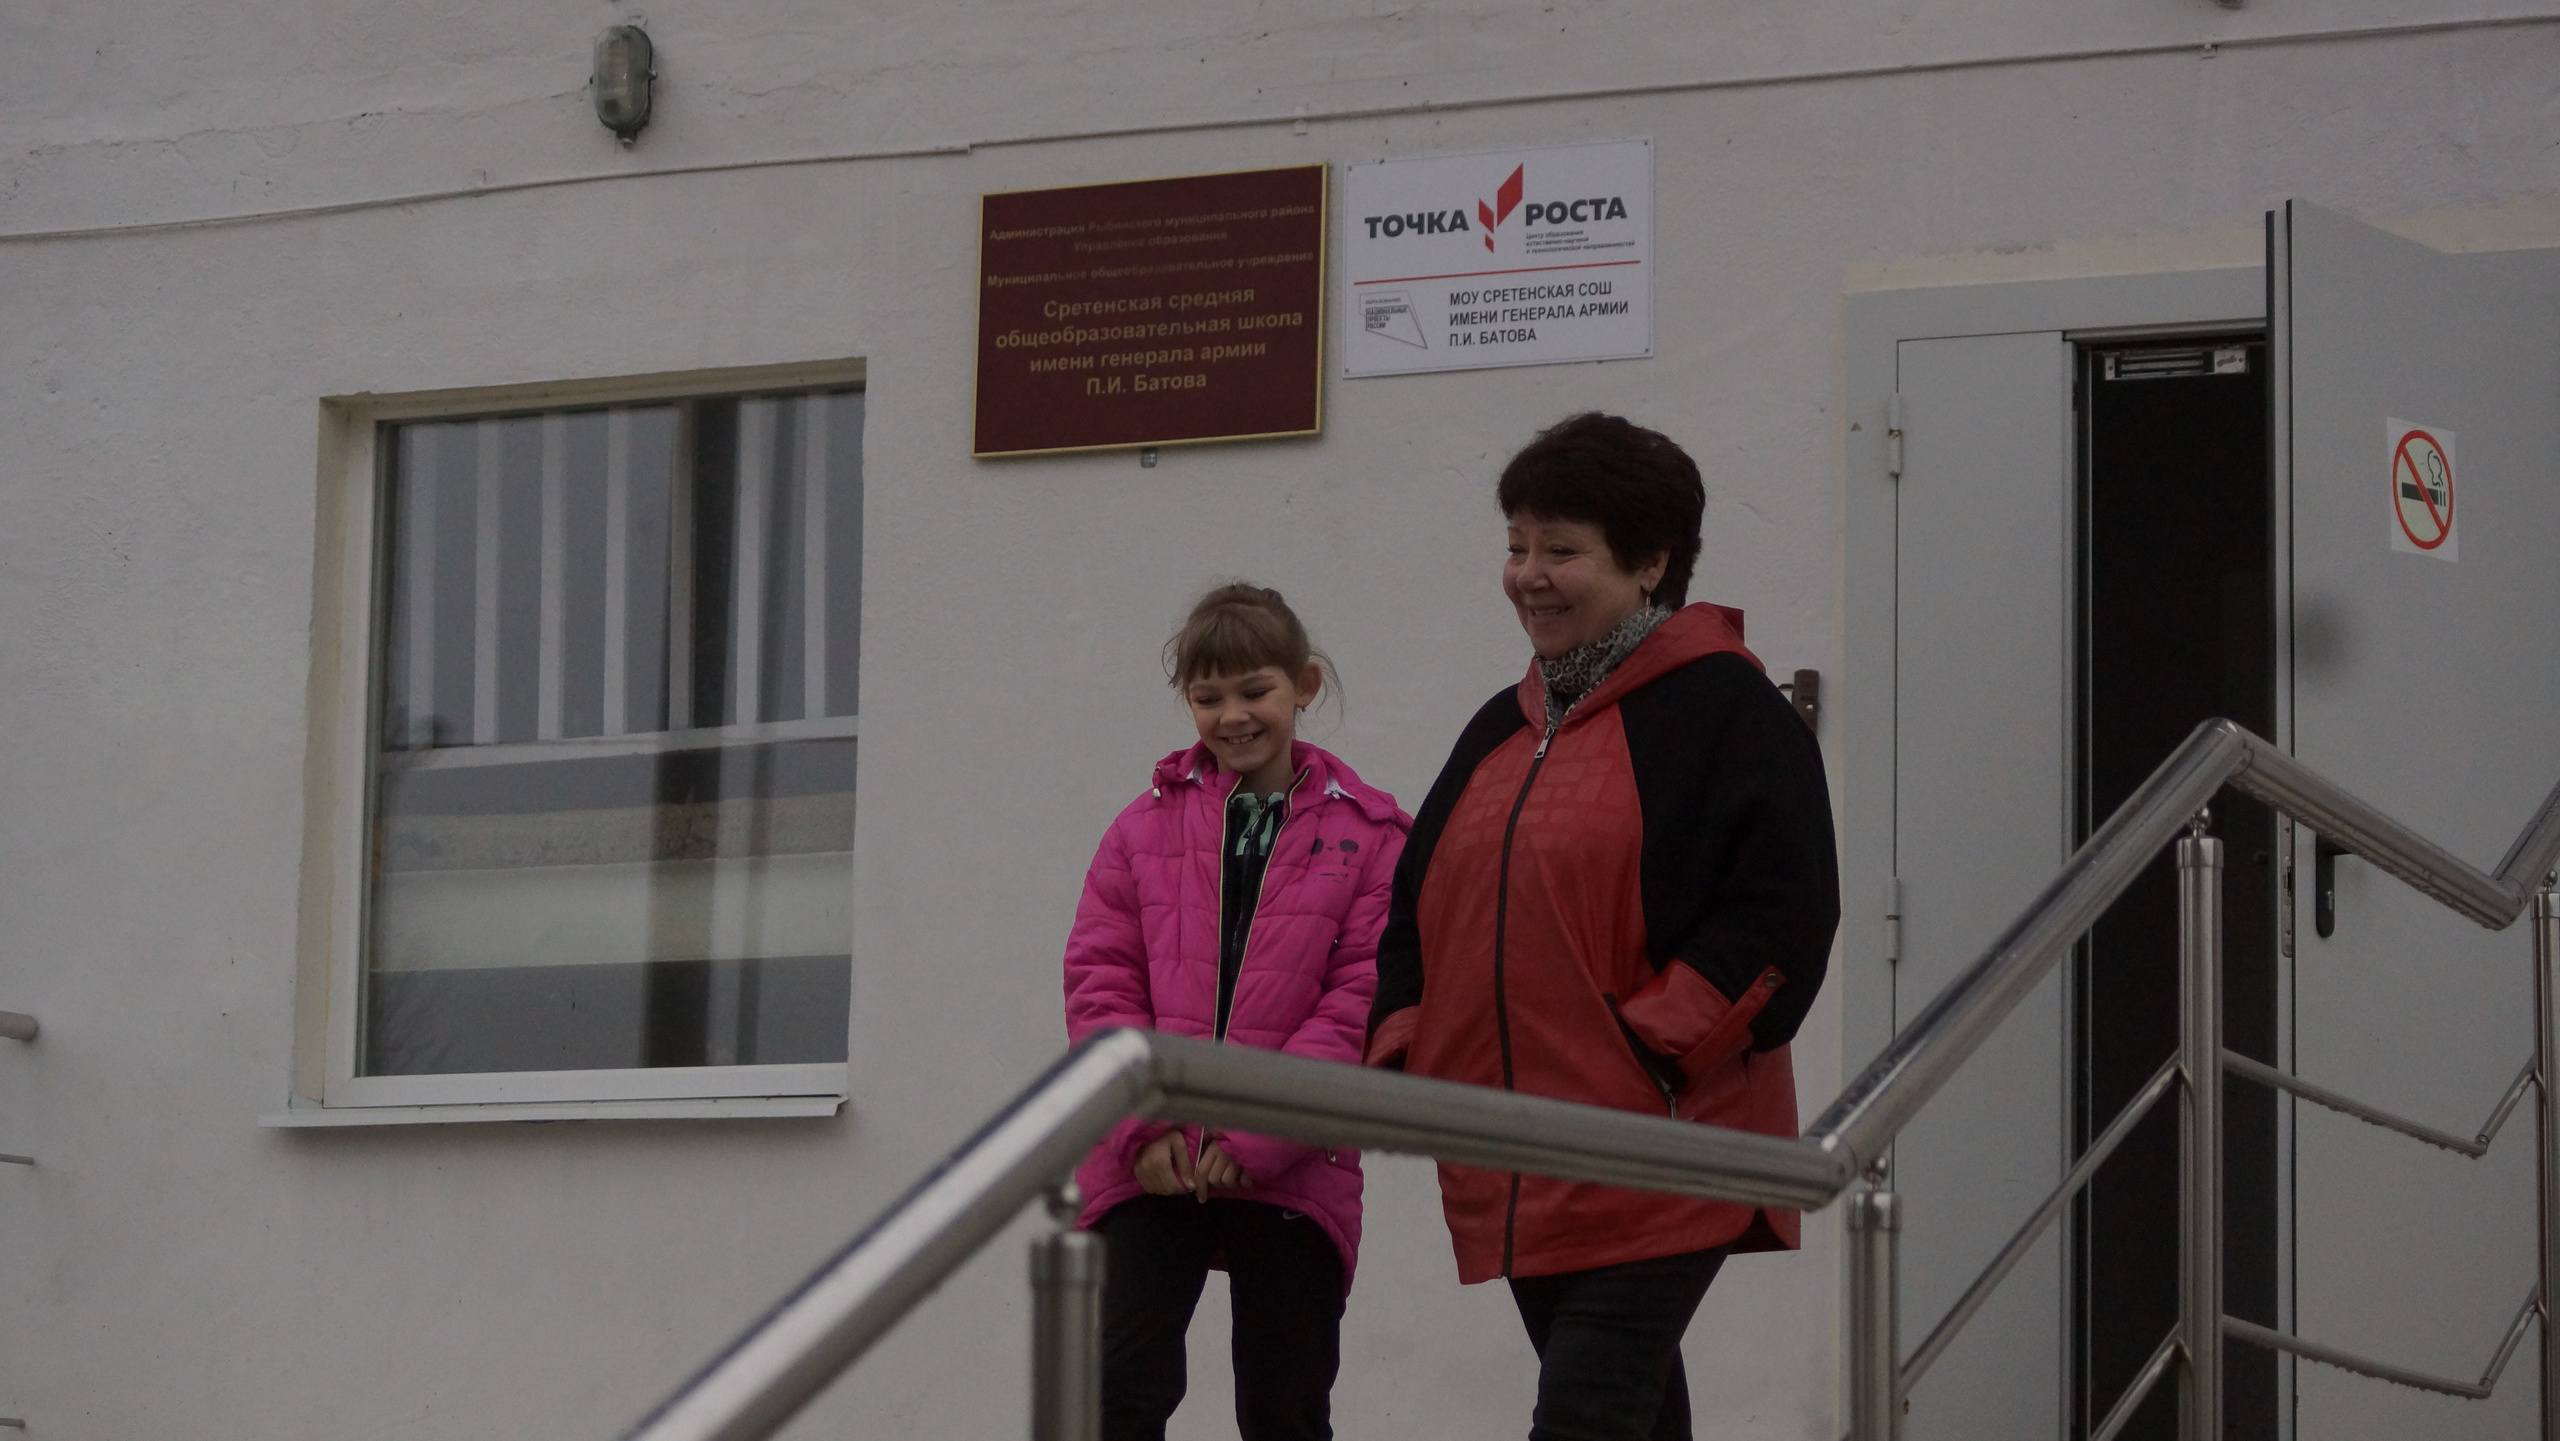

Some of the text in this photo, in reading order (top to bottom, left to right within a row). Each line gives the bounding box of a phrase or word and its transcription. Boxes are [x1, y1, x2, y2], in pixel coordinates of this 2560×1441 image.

[990, 225, 1085, 240] Администрации
[1165, 208, 1268, 227] муниципального
[1271, 205, 1314, 218] района
[1364, 197, 1628, 239] ТОЧКА РОСТА
[1148, 232, 1227, 247] образования
[987, 271, 1087, 288] Муниципальное
[1238, 251, 1314, 269] учреждение
[1044, 289, 1255, 320] Сретенская средняя
[1449, 281, 1612, 306] МОУ СРЕТЕНСКАЯ СОШ
[1449, 301, 1629, 327] ИМЕНИ ГЕНЕРАЛА АРМИИ
[996, 312, 1303, 348] общеобразовательная школа
[1449, 328, 1537, 347] П.И. БАТОВА
[1030, 342, 1266, 372] имени генерала армии
[1087, 373, 1207, 395] П.И. Батова
